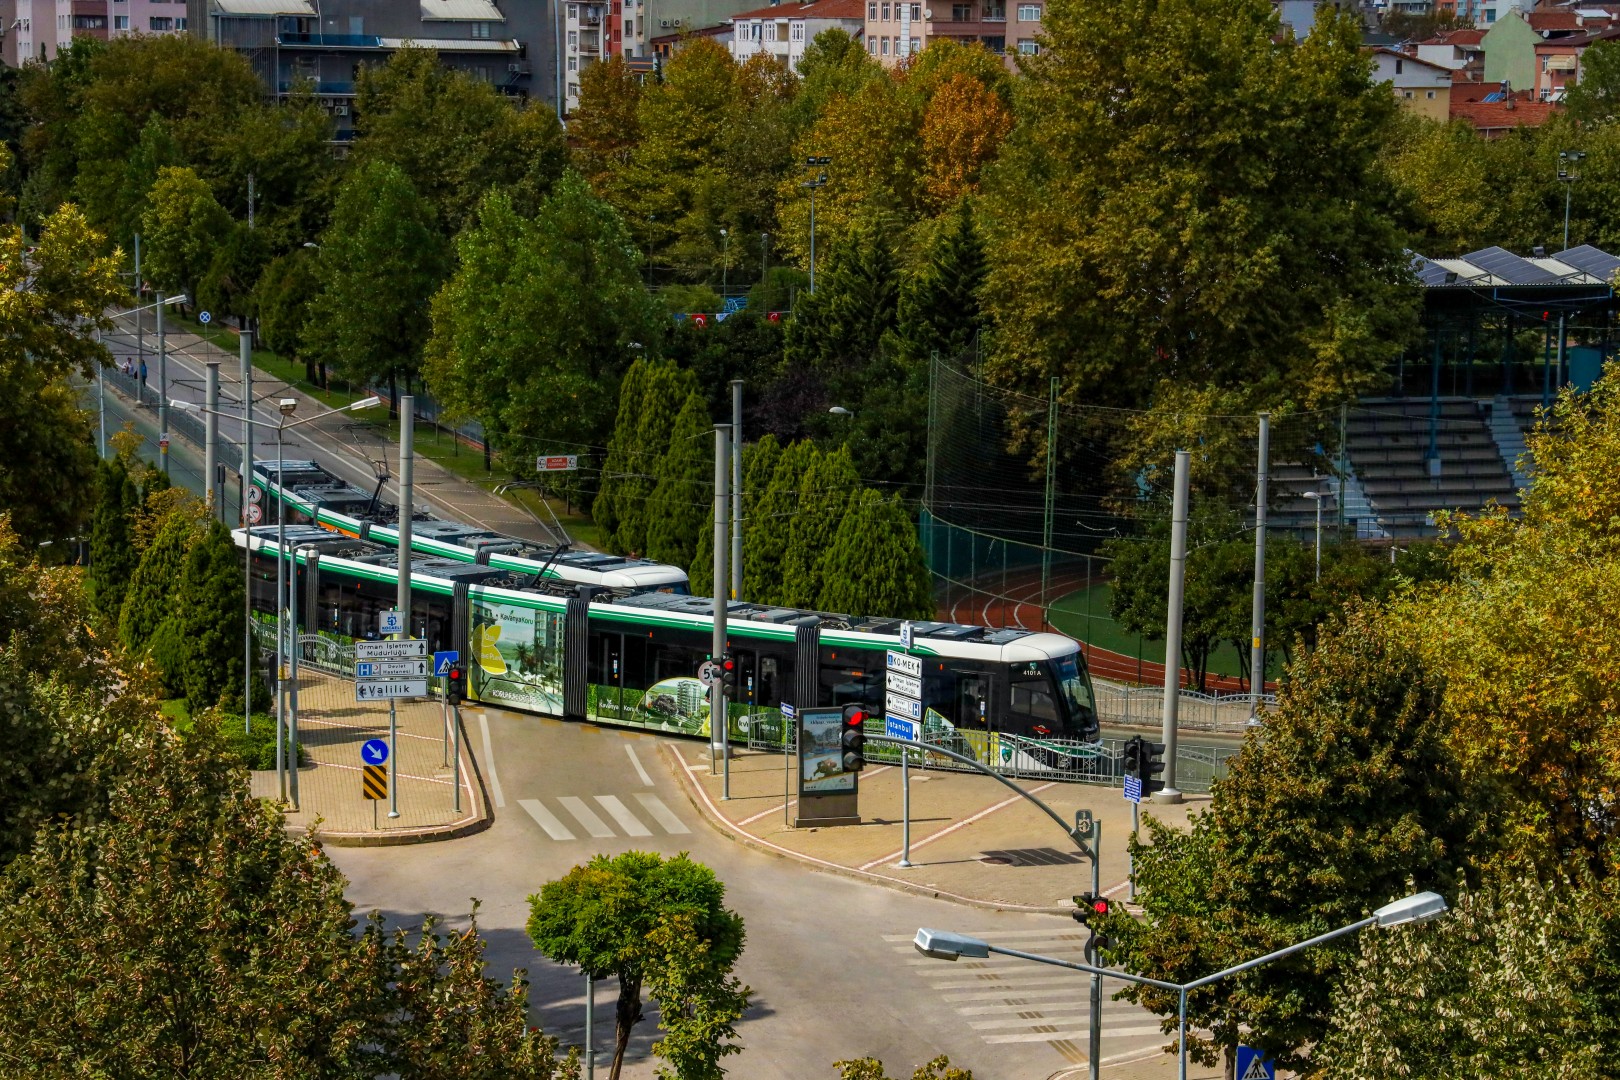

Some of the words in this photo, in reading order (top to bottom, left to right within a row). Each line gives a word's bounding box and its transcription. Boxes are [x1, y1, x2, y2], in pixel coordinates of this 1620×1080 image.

[386, 642, 413, 650] İşletme
[366, 649, 407, 657] Müdürlüğü
[368, 684, 410, 694] Valilik
